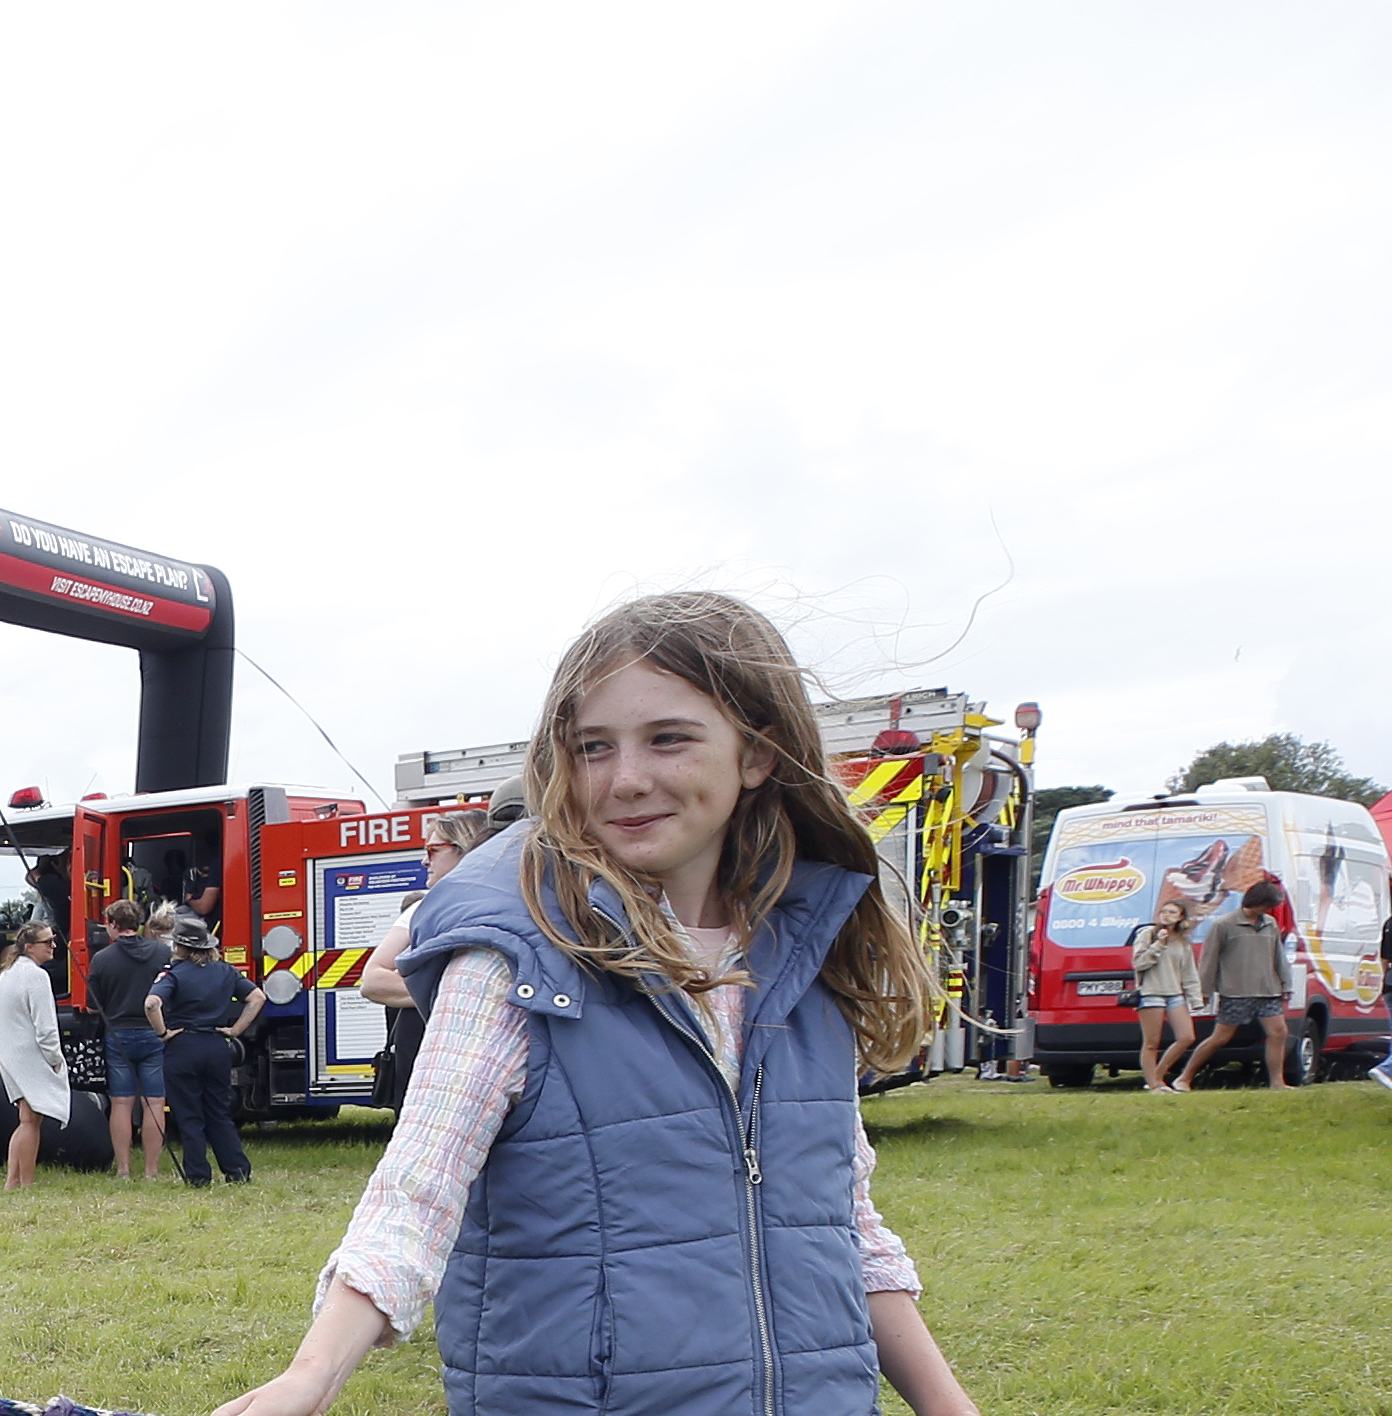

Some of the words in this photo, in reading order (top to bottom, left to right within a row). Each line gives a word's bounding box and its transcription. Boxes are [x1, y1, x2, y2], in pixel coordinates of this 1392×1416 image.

[10, 521, 32, 547] DO
[30, 526, 59, 554] YOU
[58, 536, 93, 565] HAVE
[93, 545, 111, 570] AN
[110, 551, 156, 582] ESCAPE
[154, 563, 188, 591] PLAN?
[50, 576, 74, 595] VISIT
[1102, 818, 1132, 829] mind
[1136, 817, 1159, 827] that
[1162, 813, 1217, 825] tamariki!
[340, 815, 411, 847] FIRE
[1052, 919, 1086, 930] 0800
[1088, 918, 1098, 927] 4
[1100, 916, 1140, 929] Whippy
